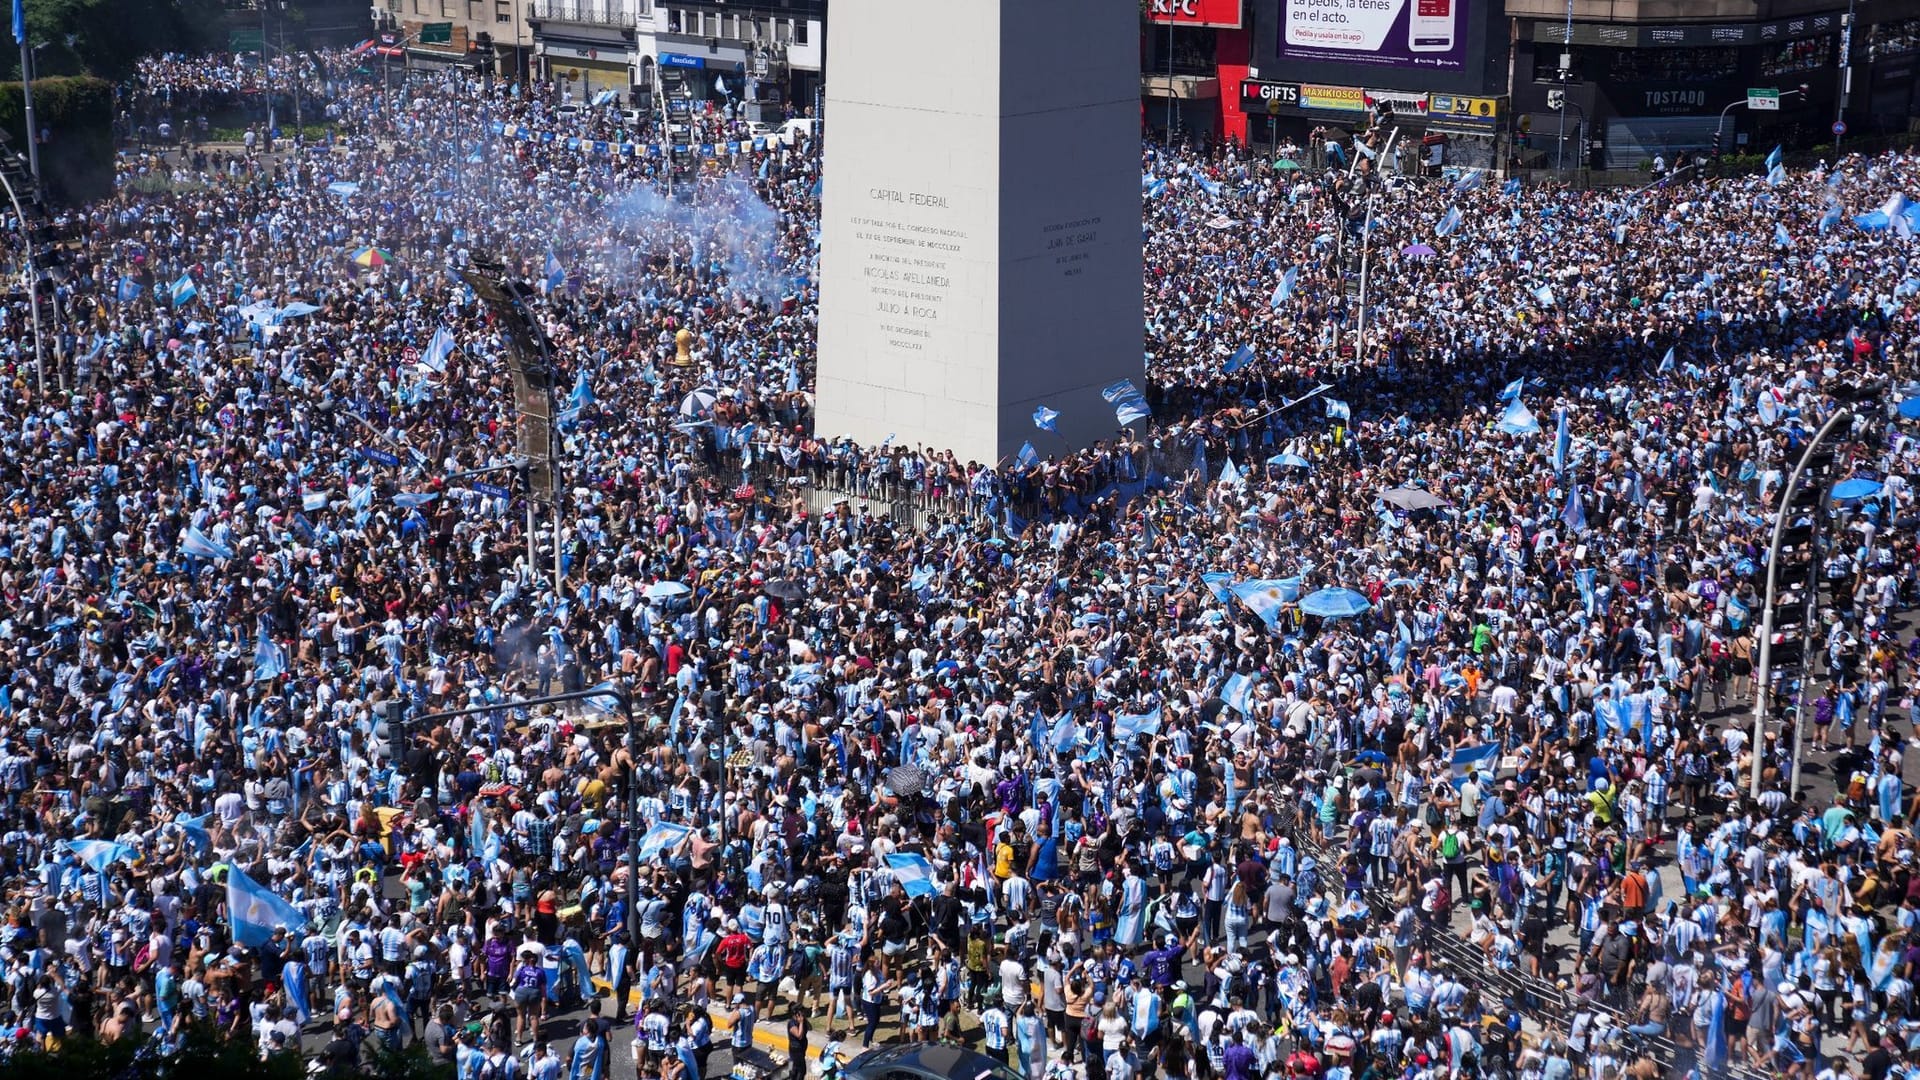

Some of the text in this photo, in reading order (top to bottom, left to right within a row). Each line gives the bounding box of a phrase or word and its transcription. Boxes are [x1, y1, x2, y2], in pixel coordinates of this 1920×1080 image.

[1293, 9, 1349, 24] en el acto.
[1303, 87, 1361, 99] MAXIKIOSCO
[1645, 90, 1705, 107] TOSTADO
[870, 188, 949, 209] CAPITAL FEDERAL
[903, 272, 951, 288] AVELLANEDA
[912, 306, 937, 319] ROCA
[1705, 586, 1714, 595] 10
[1149, 603, 1158, 612] 23
[765, 911, 782, 925] 10
[1213, 1046, 1223, 1057] 10
